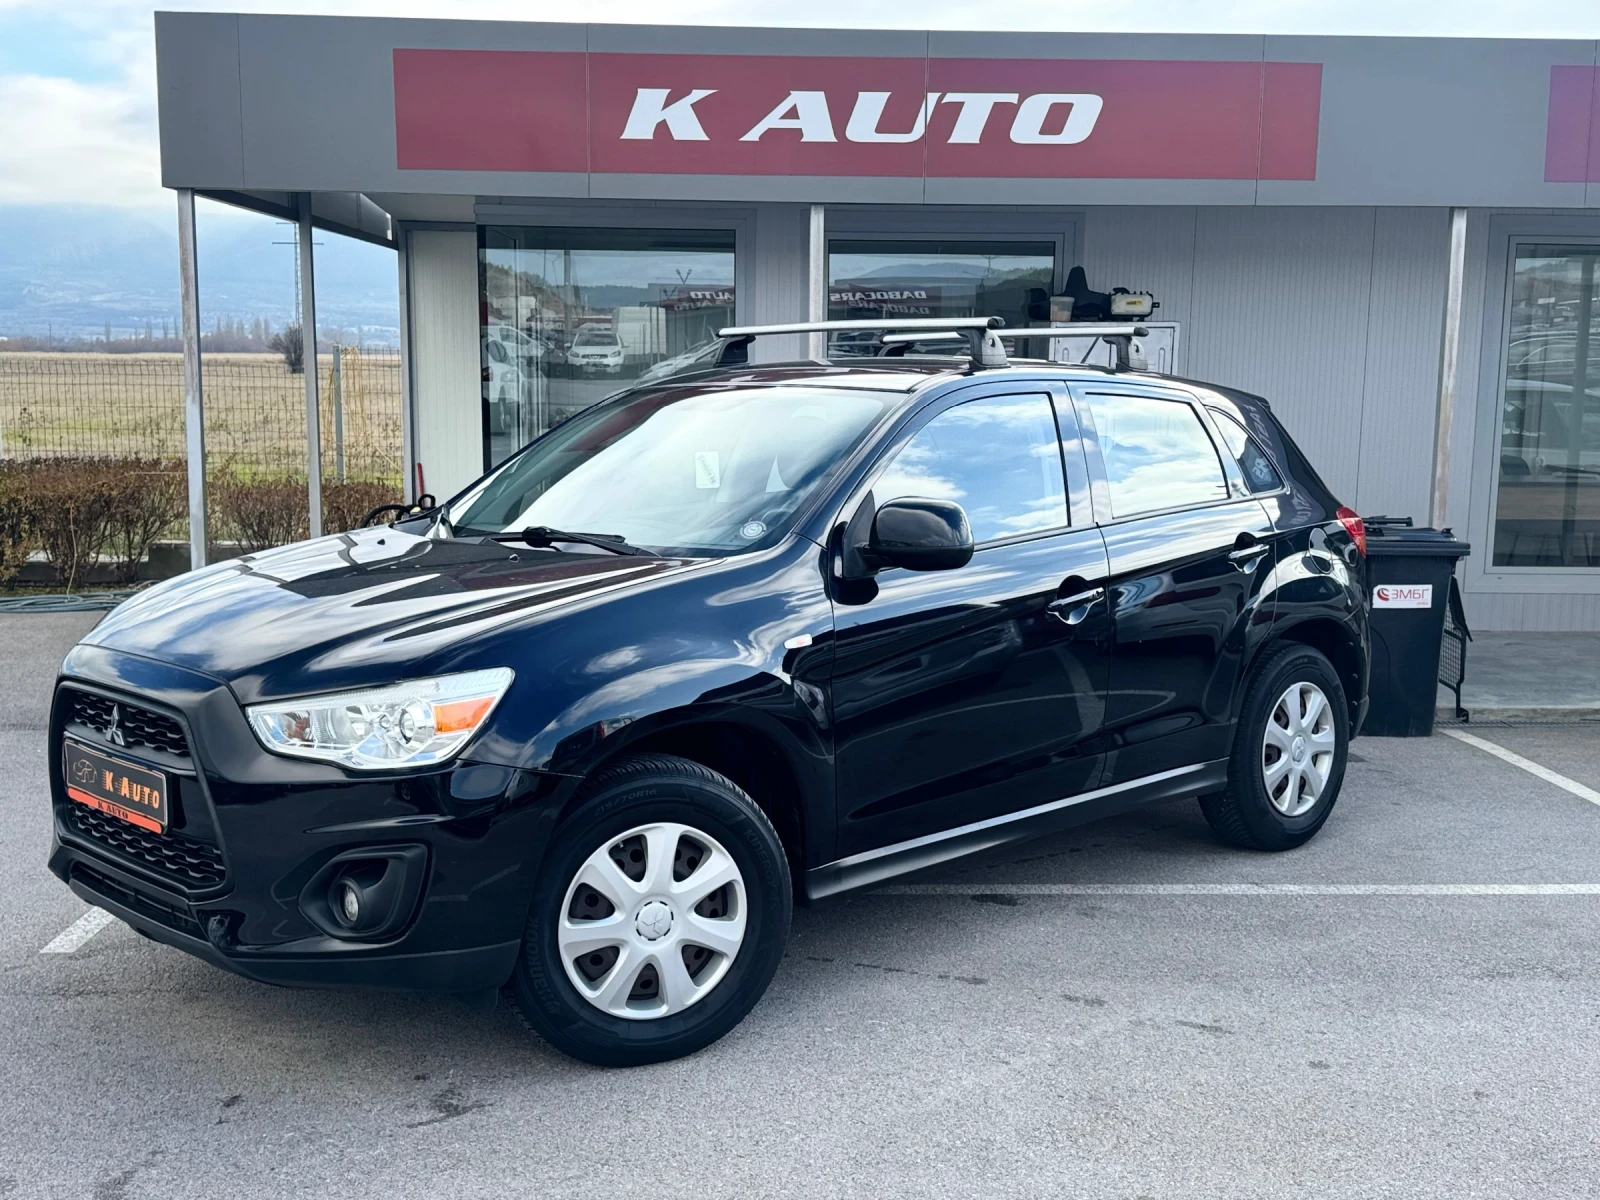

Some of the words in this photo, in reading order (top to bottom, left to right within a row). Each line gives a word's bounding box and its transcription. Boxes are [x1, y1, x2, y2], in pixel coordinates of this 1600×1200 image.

[620, 88, 719, 141] K
[738, 91, 1104, 145] AUTO
[103, 769, 114, 792] K
[119, 776, 160, 809] AUTO
[97, 800, 104, 811] K
[106, 805, 129, 820] AUTO
